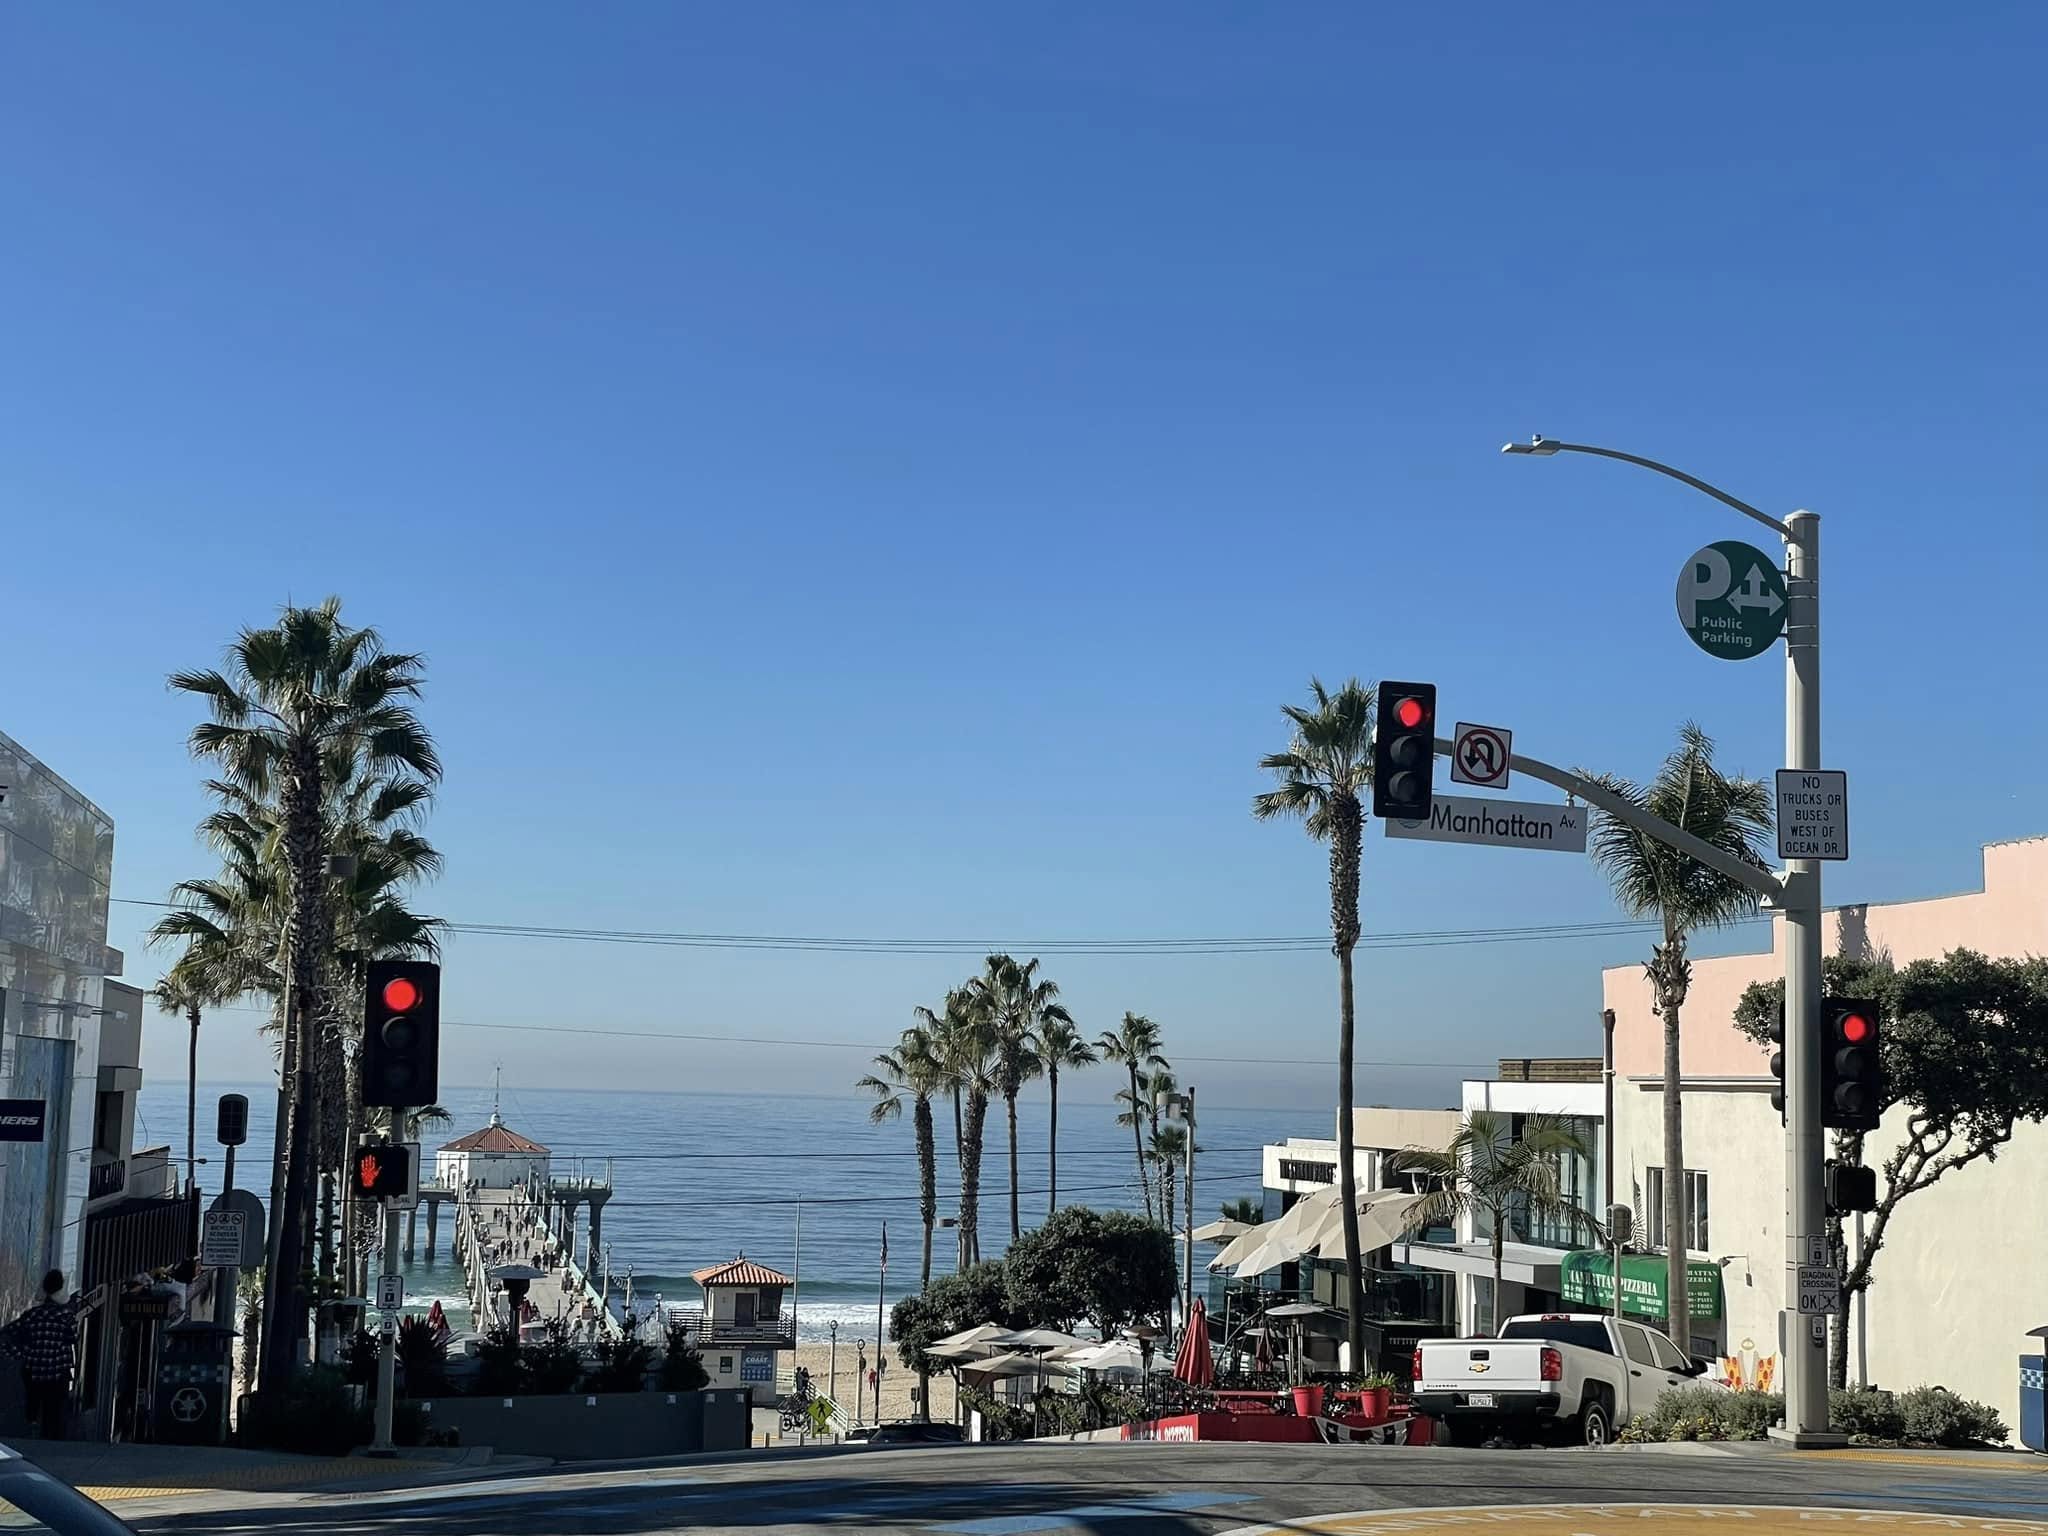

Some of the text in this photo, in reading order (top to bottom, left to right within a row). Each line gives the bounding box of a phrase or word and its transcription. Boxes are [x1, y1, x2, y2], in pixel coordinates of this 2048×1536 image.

[1678, 547, 1731, 628] P
[1702, 616, 1743, 630] Public
[1702, 631, 1753, 647] Parking
[1802, 776, 1820, 789] NO
[1783, 793, 1841, 806] TRUCKS OR
[1431, 804, 1577, 839] Manhattan Av.
[1795, 810, 1829, 821] BUSES
[1791, 825, 1835, 838] WEST OF
[1785, 841, 1819, 854] OCEAN
[1801, 1271, 1836, 1280] DIAGONAL
[1801, 1280, 1836, 1288] CROSSING
[1801, 1294, 1817, 1309] OK
[1798, 1511, 2048, 1535] BEAC
